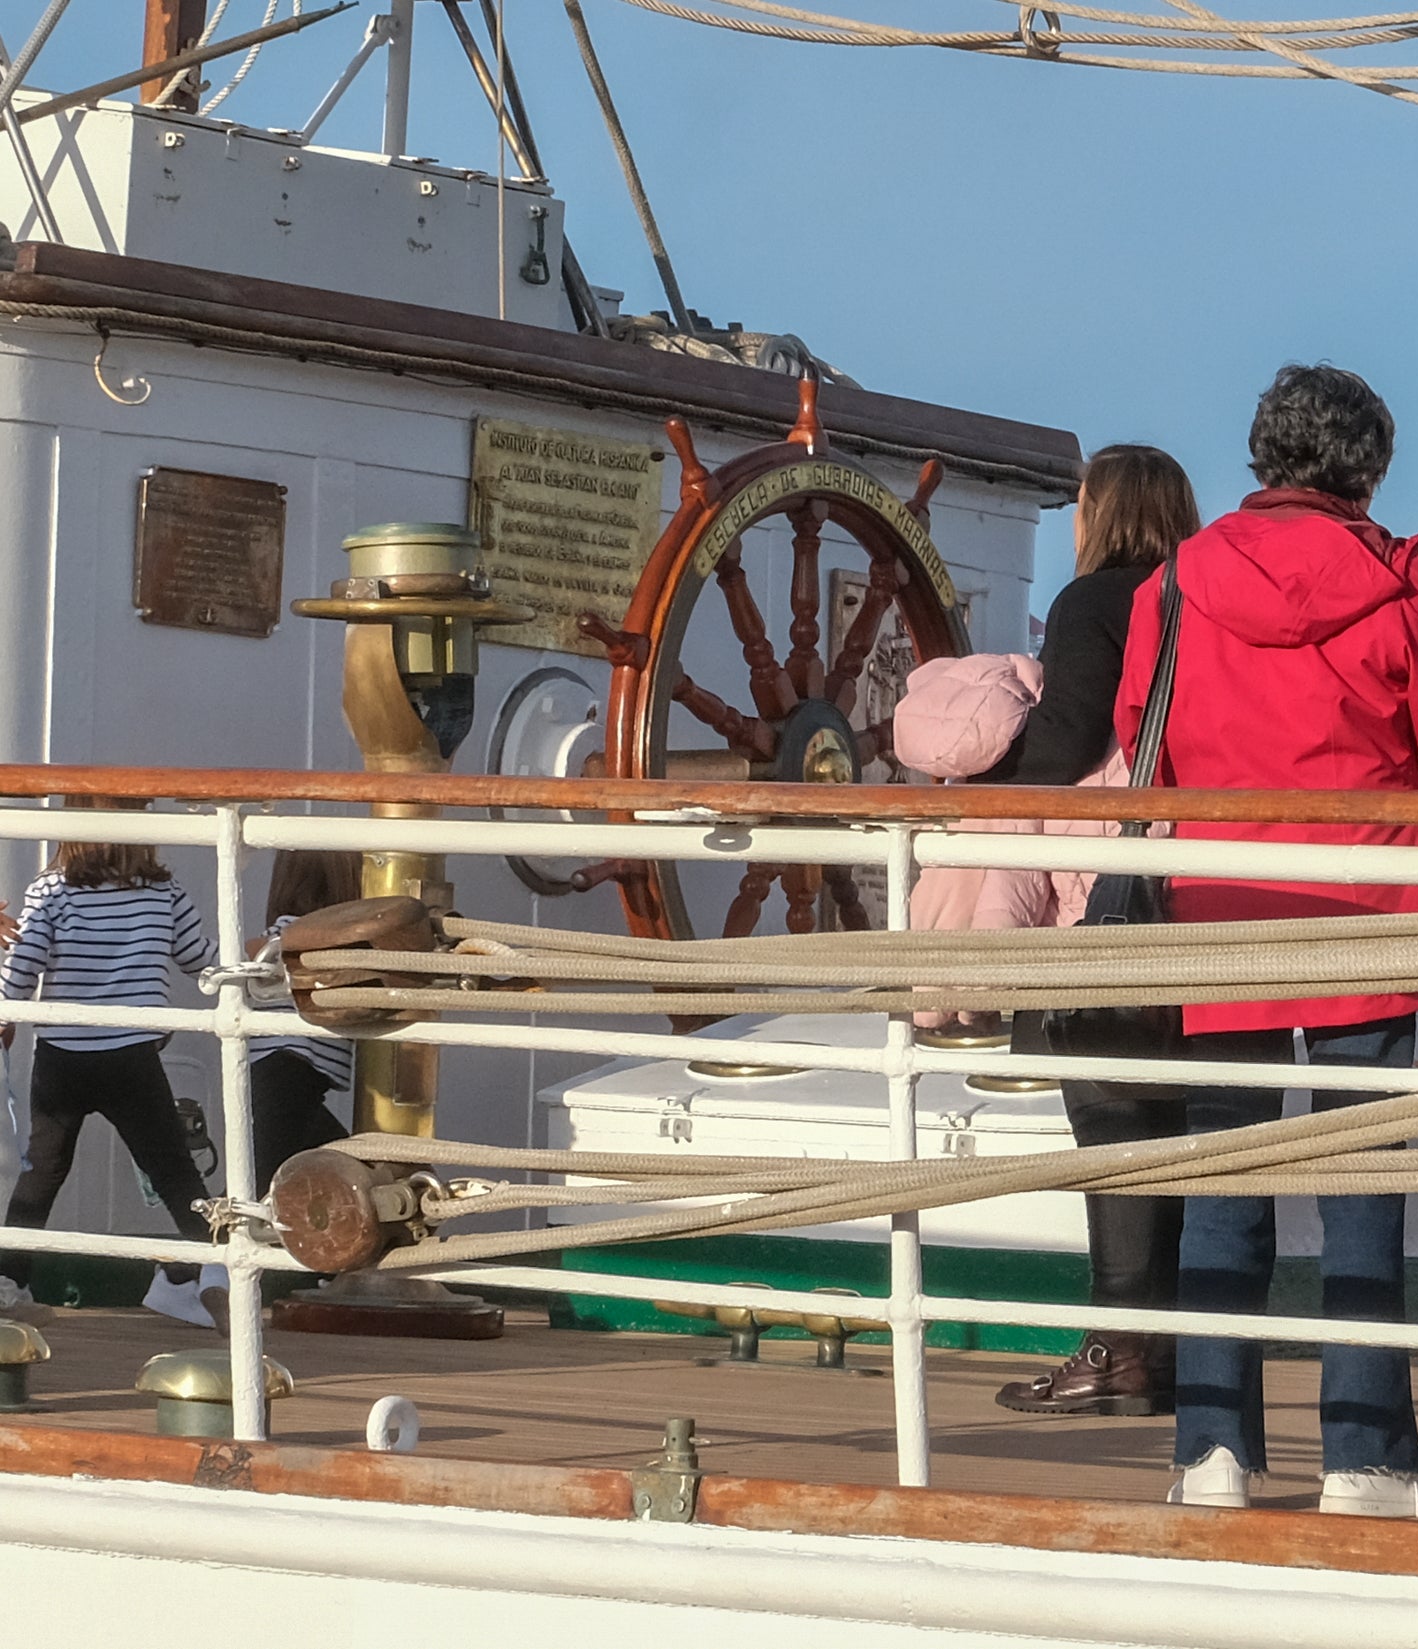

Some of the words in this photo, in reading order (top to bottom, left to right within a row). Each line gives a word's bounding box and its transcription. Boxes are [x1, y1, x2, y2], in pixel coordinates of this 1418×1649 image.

[489, 430, 538, 455] INSTITUTO
[540, 439, 555, 458] DE
[555, 442, 597, 466] CULTURA
[500, 464, 512, 481] AL
[513, 464, 541, 485] JUAN
[544, 468, 598, 495] SEBASTIAN
[705, 482, 769, 560] ESCUELA
[779, 467, 799, 493] DE
[814, 464, 885, 510] GUARDIAS
[894, 506, 949, 590] MARINAS
